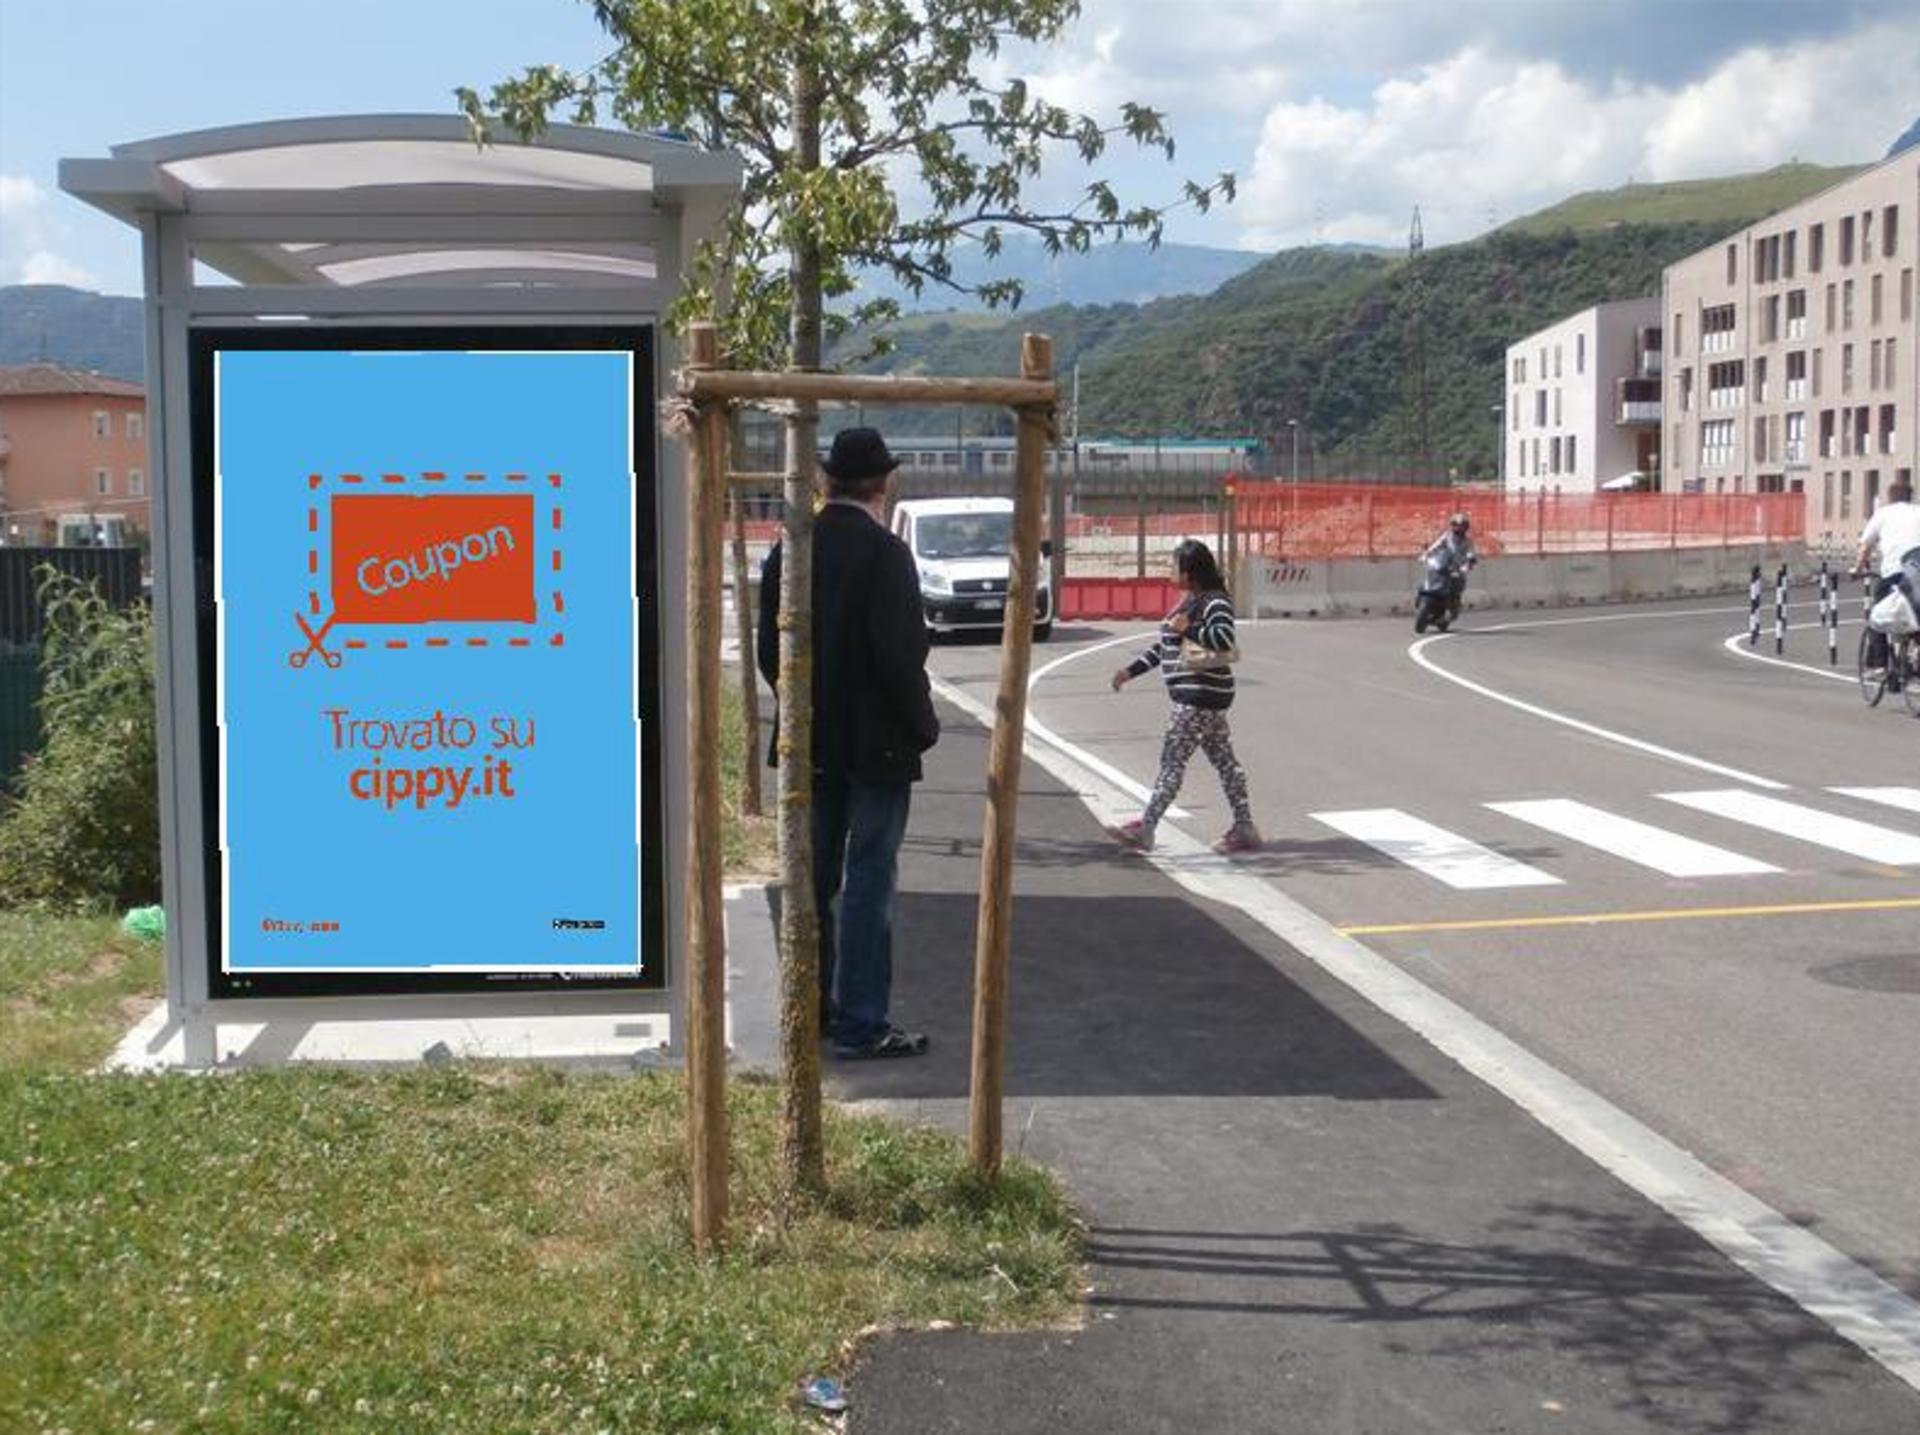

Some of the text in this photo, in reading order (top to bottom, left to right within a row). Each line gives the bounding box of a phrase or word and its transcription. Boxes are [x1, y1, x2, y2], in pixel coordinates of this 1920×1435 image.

[357, 525, 515, 595] Coupon
[322, 710, 535, 750] Trovato su
[350, 755, 515, 809] cippy.it
